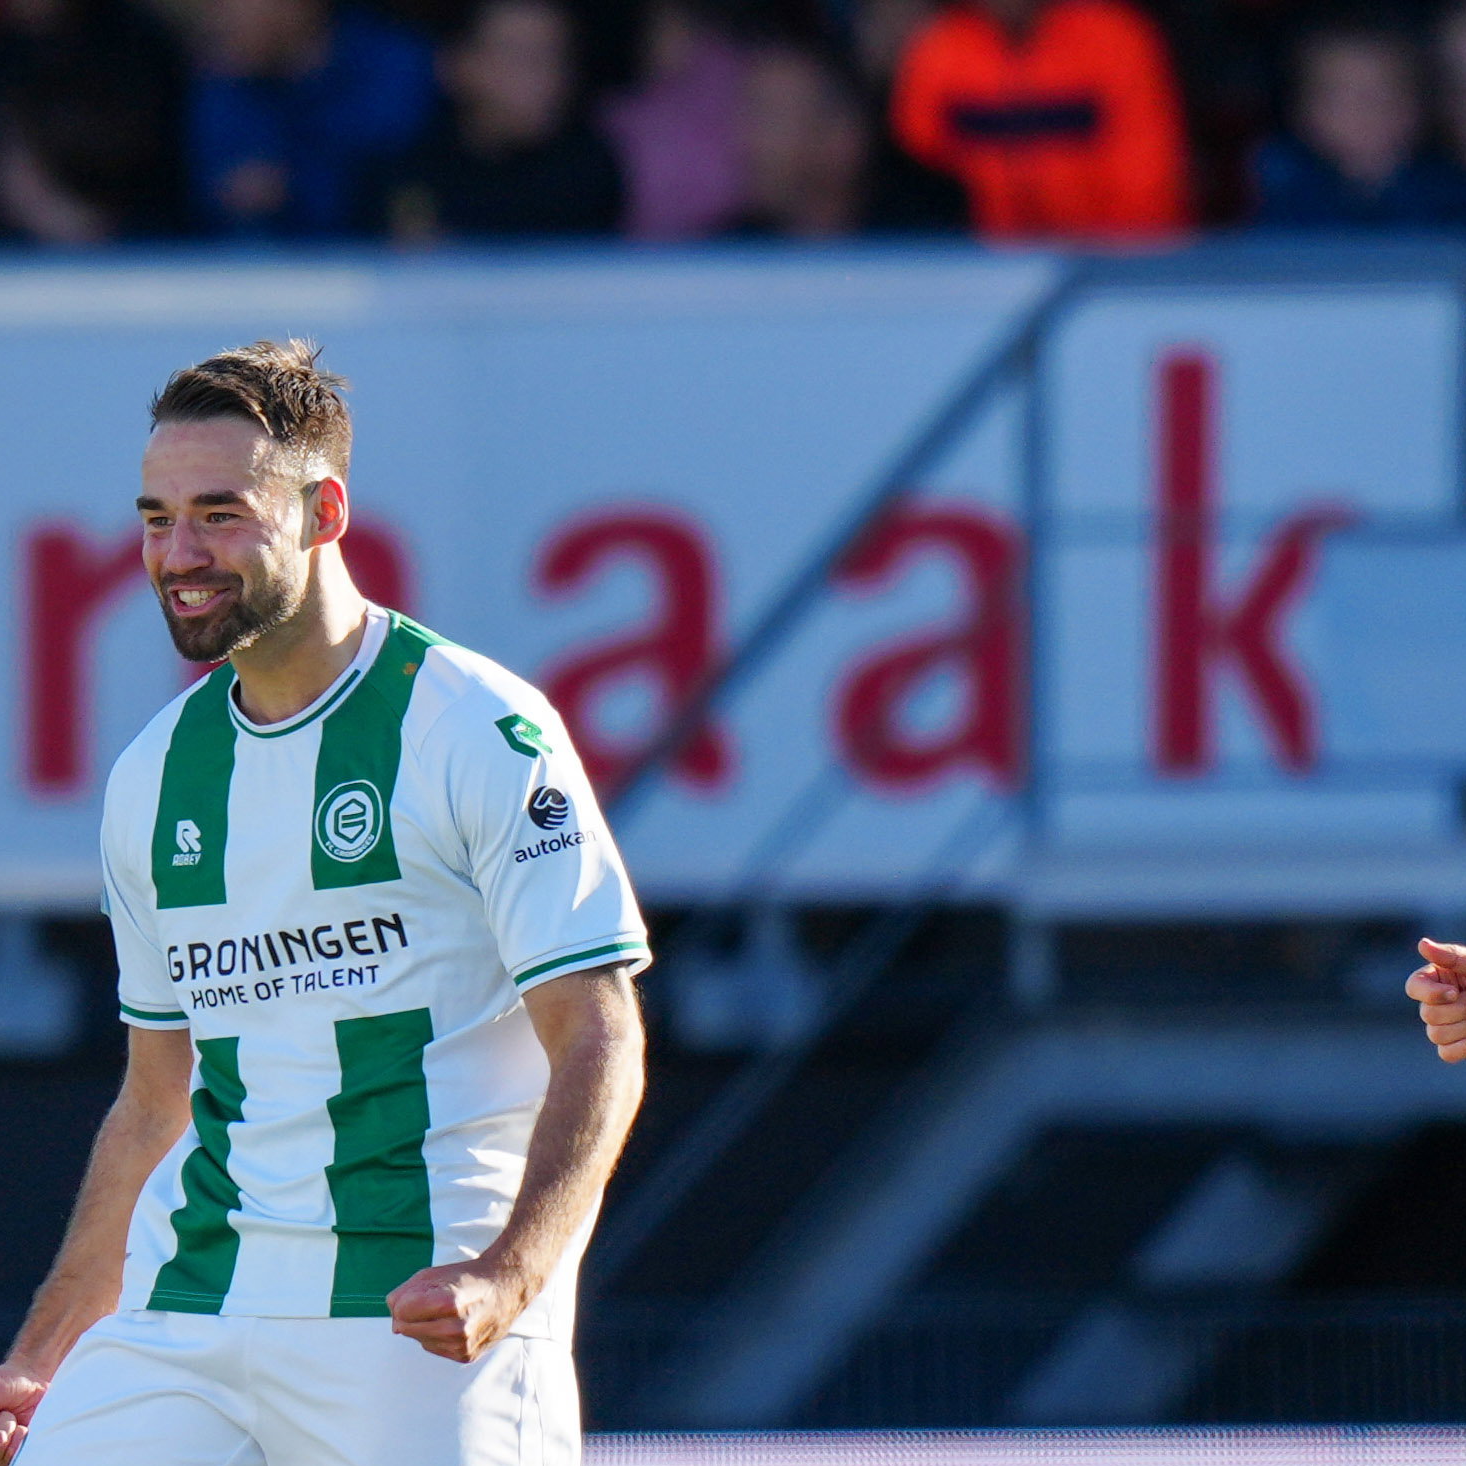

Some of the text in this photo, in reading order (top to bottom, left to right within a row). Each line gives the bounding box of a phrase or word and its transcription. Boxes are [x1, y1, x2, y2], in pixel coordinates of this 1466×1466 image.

[166, 912, 409, 983] GRONINGEN
[190, 964, 381, 1010] HOME OF TALENT
